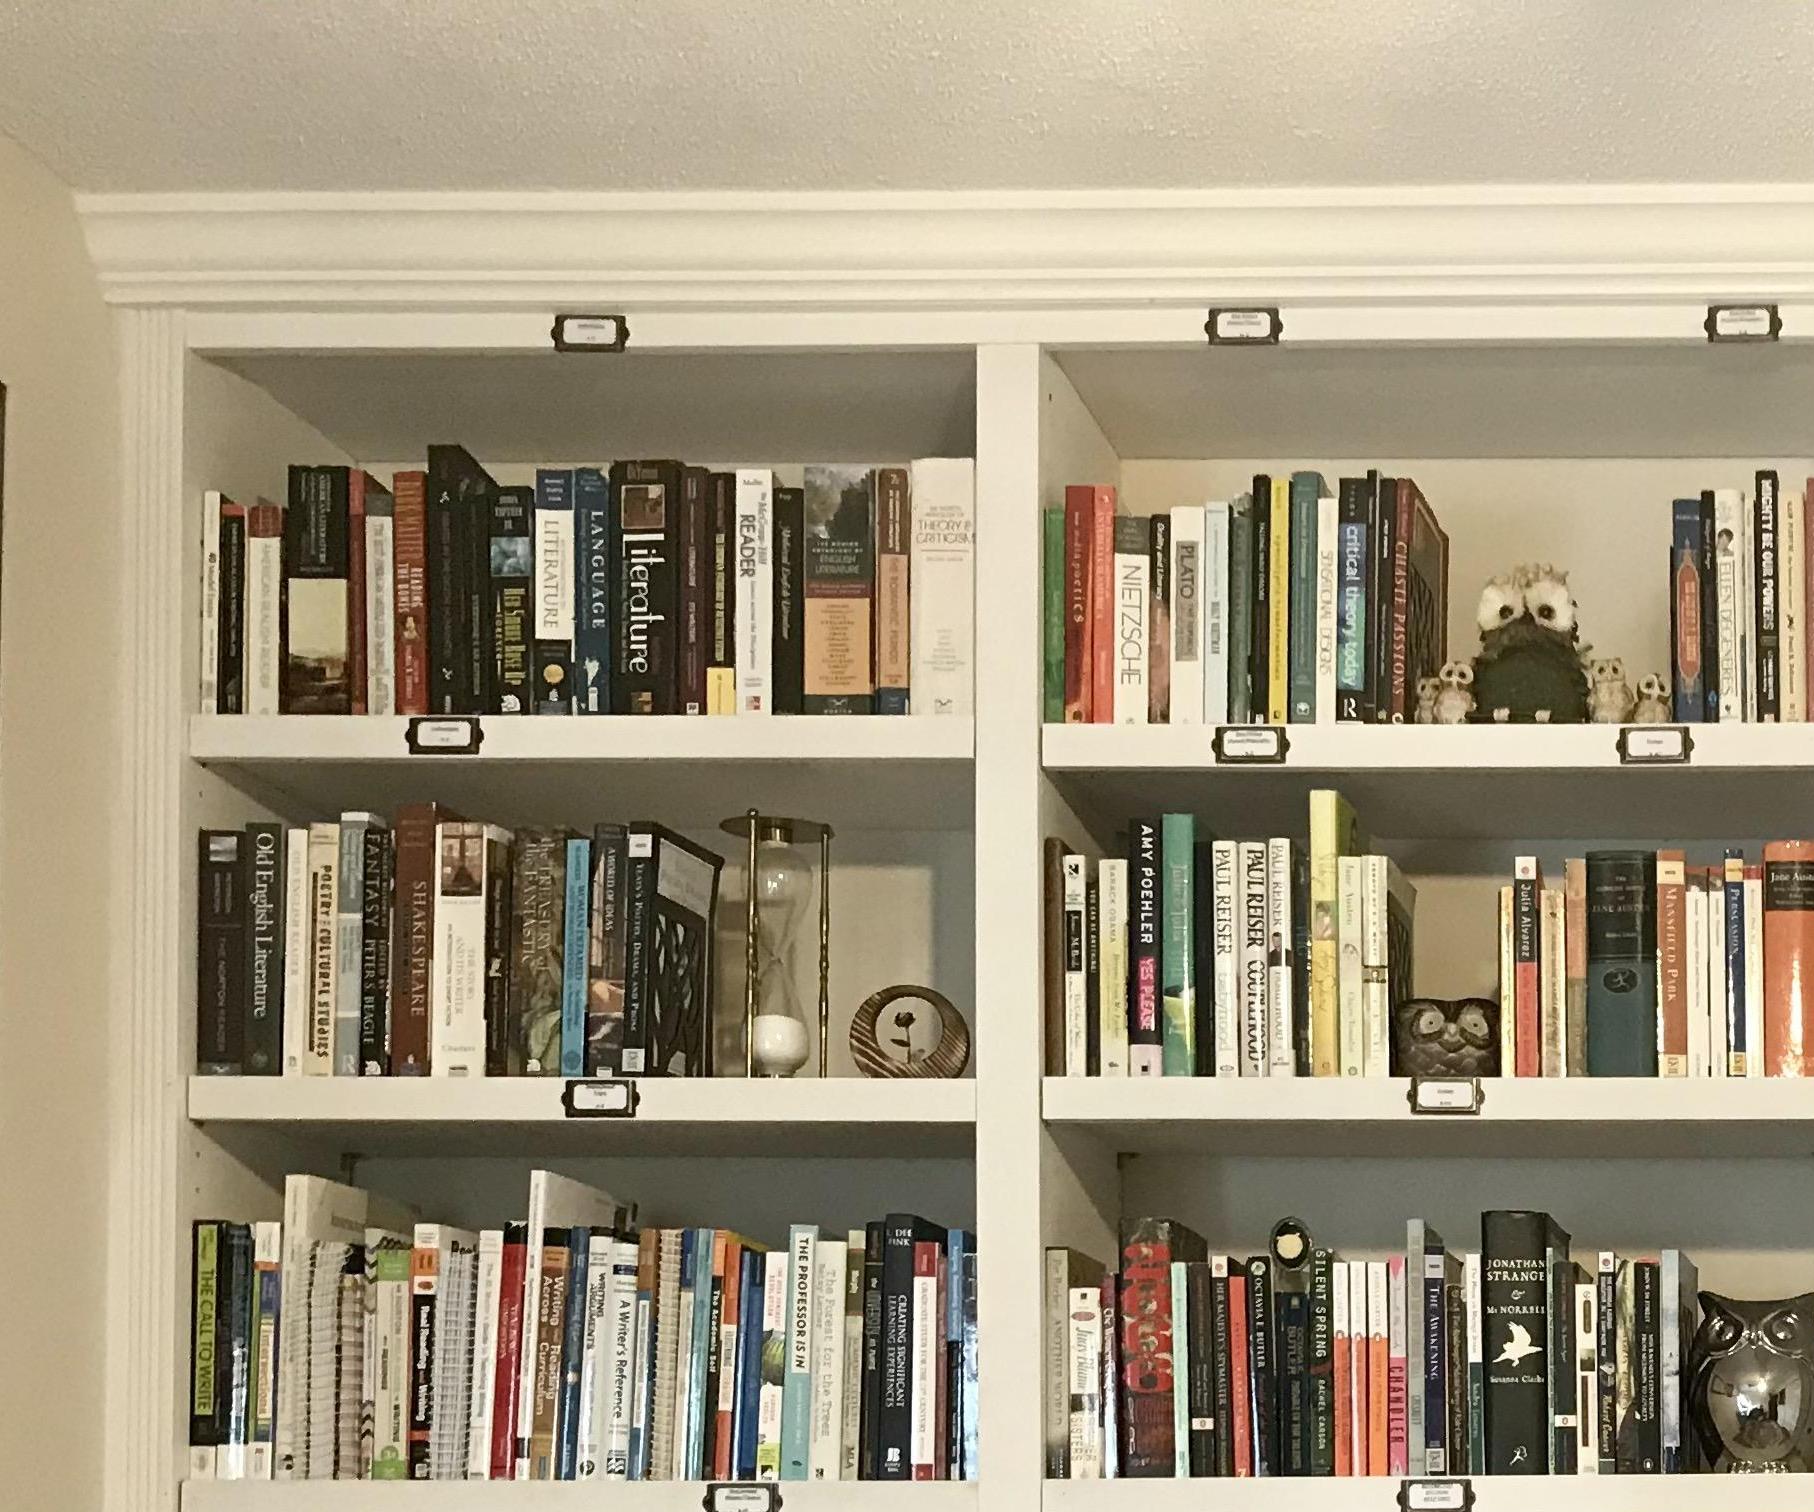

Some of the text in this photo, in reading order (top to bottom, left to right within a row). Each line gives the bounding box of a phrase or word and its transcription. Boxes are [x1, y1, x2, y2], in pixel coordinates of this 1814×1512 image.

[543, 520, 559, 628] LITERATURE
[591, 511, 605, 629] LANGUAGE
[740, 514, 756, 577] READER
[1180, 544, 1195, 599] PLATO
[1761, 479, 1774, 630] MIGHTY BE OUR POWERS
[622, 534, 665, 673] Literature
[1120, 565, 1142, 685] NIETZSCHE
[1342, 525, 1360, 686] critical theory today
[1392, 541, 1408, 696] CHASTE PASSIONS
[366, 834, 380, 927] FANTASY
[1140, 825, 1156, 944] AMY POEHLER
[1215, 849, 1232, 956] PAUL REISER
[1246, 893, 1265, 949] REISER
[1247, 849, 1265, 890] PAUL
[1520, 884, 1532, 957] Julia Alvarez
[249, 833, 274, 1019] Old English Literature
[411, 881, 427, 1017] SHAKESPEARE
[1140, 958, 1154, 1030] YES PLEASE
[541, 1276, 552, 1322] Across
[550, 1276, 564, 1326] Writing
[586, 1283, 598, 1350] ARGUMENTS
[596, 1273, 606, 1317] WRITING
[795, 1238, 808, 1368] THE PROFESSOR IS IN
[1315, 1250, 1326, 1358] SILENT SPRING
[1486, 1260, 1544, 1269] JONATHAN
[1487, 1272, 1544, 1281] STRANGE
[197, 1269, 214, 1410] THE CALL TO WRITE
[536, 1342, 549, 1415] Curriculum
[546, 1344, 560, 1400] Reading
[614, 1300, 631, 1418] A Writer's Reference
[821, 1270, 836, 1436] The Forest for the Trees
[886, 1295, 897, 1408] LEARNING EXPERIENCES
[896, 1294, 907, 1407] CREATING SIGNIFICANT
[1429, 1285, 1440, 1381] THE AWAKENING
[1389, 1366, 1404, 1443] CHANDLER
